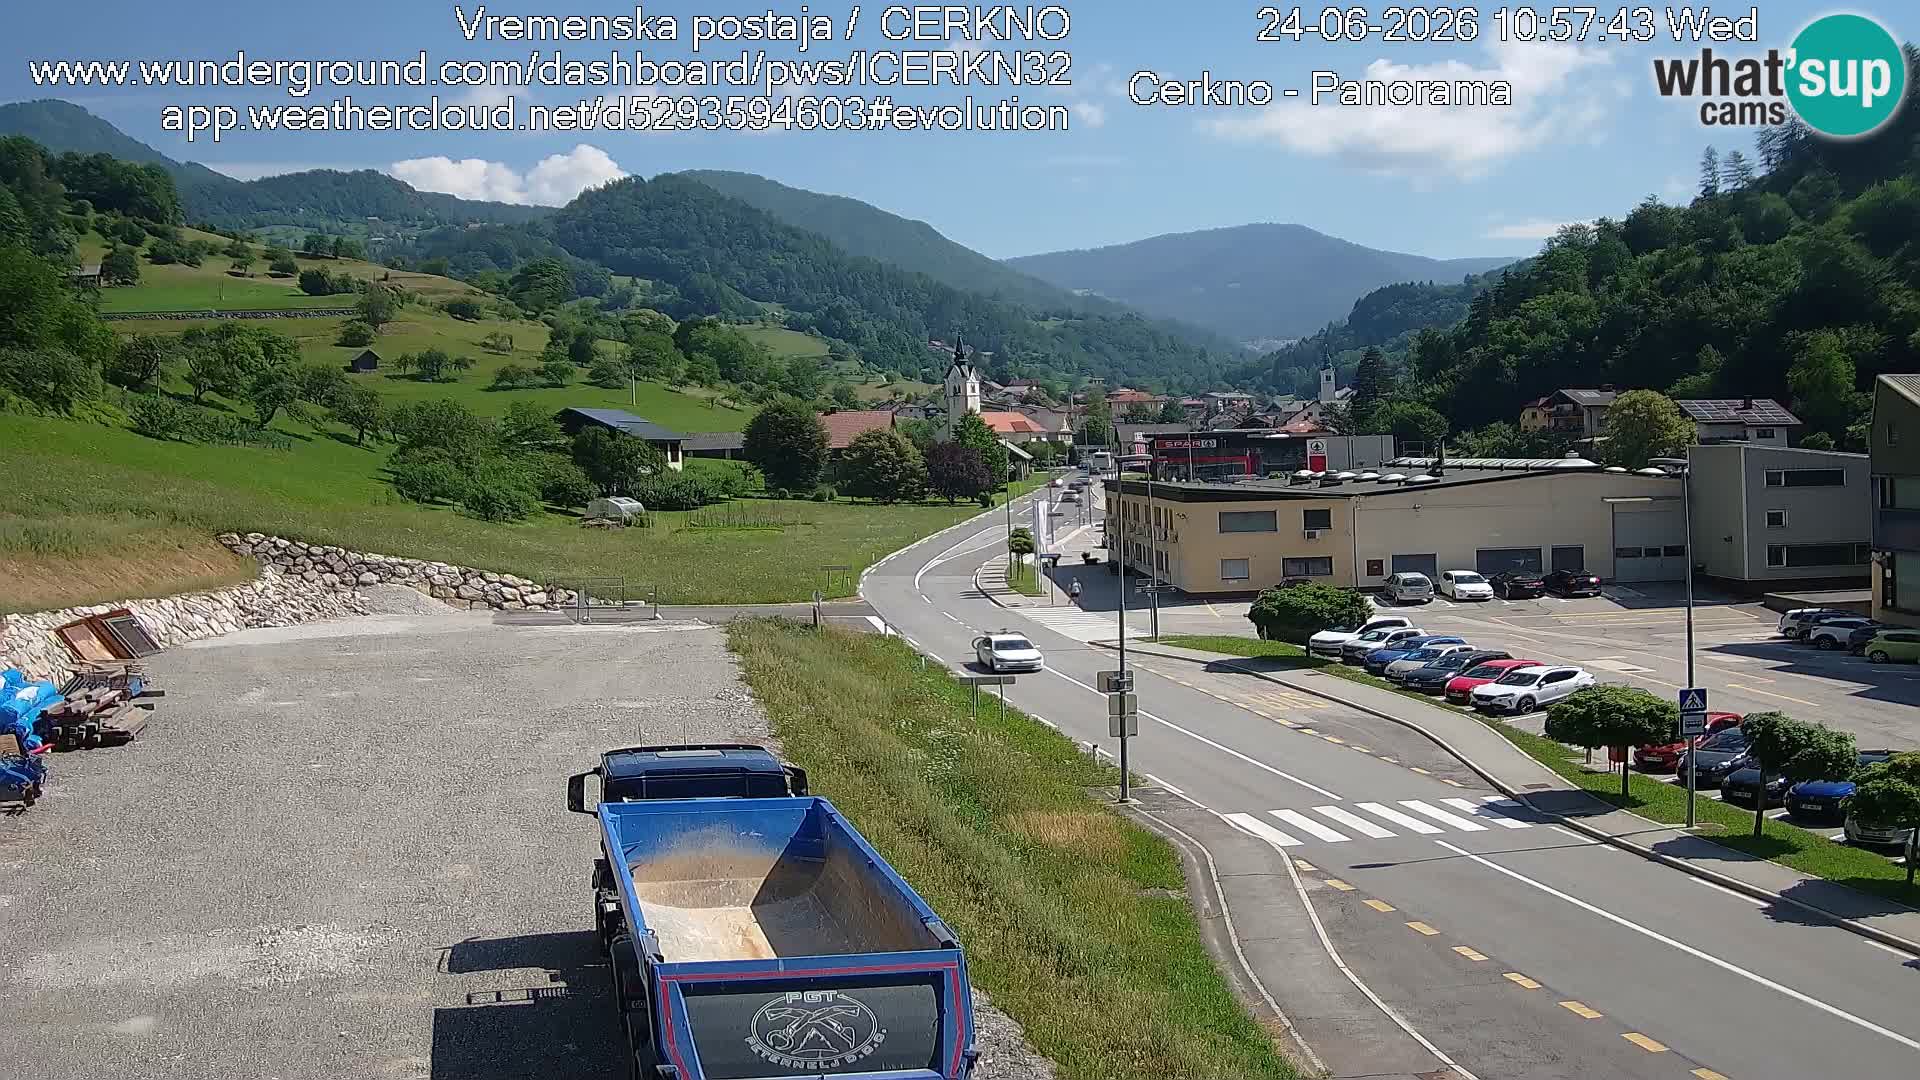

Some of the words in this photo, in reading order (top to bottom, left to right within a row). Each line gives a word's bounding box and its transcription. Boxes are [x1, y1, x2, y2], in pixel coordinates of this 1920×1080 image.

[1164, 441, 1201, 449] SPAR
[785, 990, 838, 1004] PGT
[745, 1036, 840, 1070] PETERNELJ
